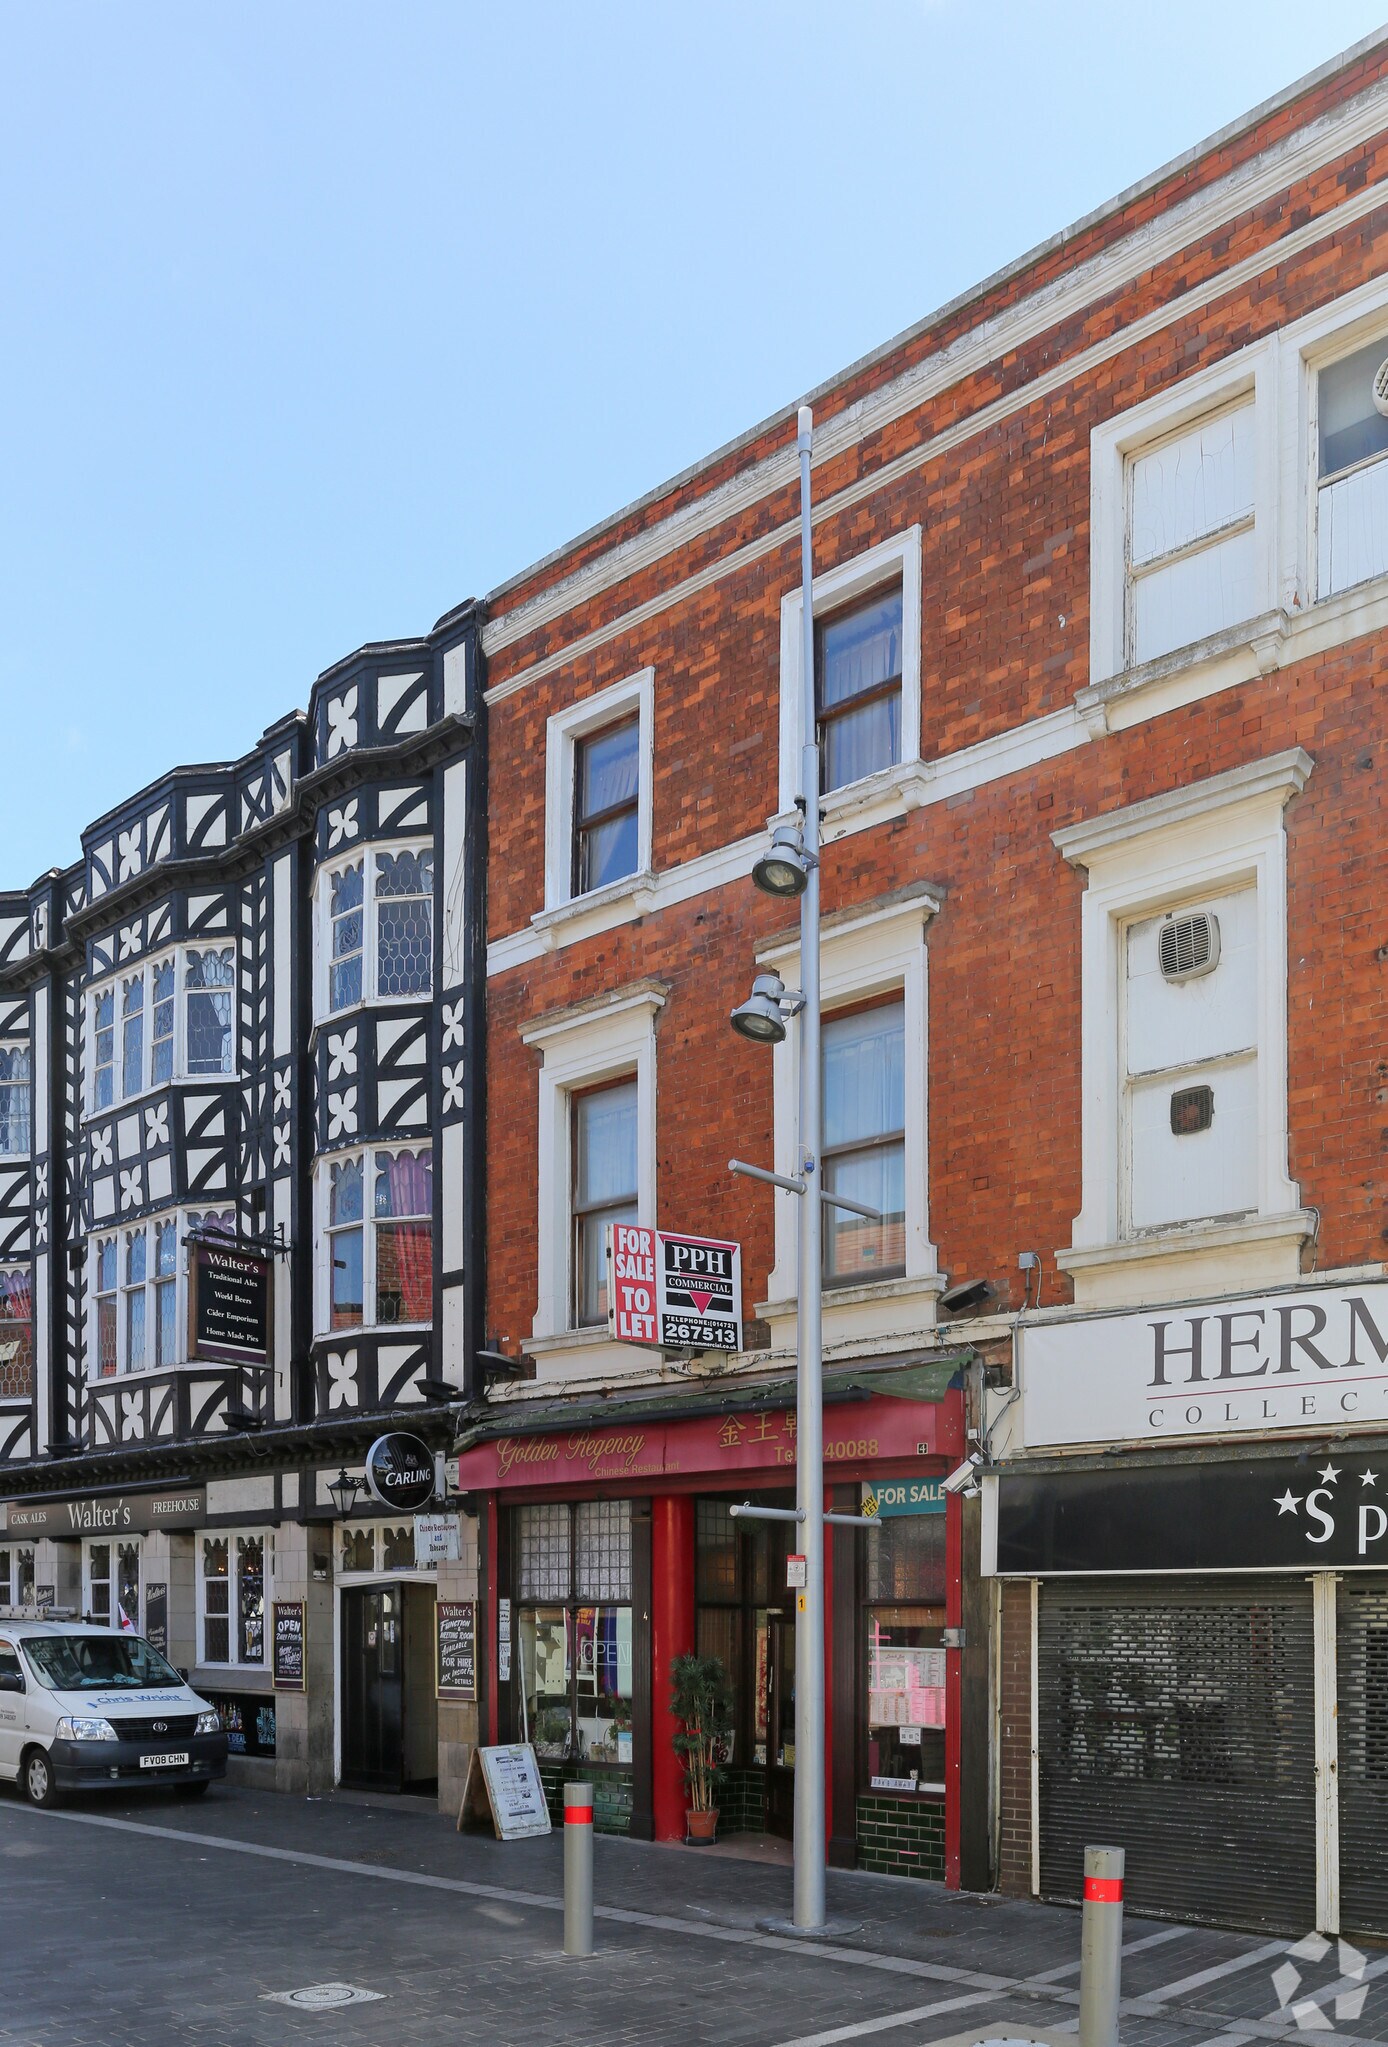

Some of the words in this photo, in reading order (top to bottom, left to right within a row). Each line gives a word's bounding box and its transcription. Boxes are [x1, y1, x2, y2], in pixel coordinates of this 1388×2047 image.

[618, 1227, 651, 1256] FOR
[208, 1252, 259, 1273] Walter's
[616, 1253, 654, 1282] SALE
[672, 1245, 726, 1275] PPH
[208, 1271, 242, 1284] Traditional
[244, 1279, 258, 1287] Ales
[668, 1277, 731, 1293] COMMERCIAL
[214, 1291, 233, 1300] World
[235, 1294, 252, 1304] Beers
[621, 1286, 650, 1312] TO
[206, 1308, 225, 1318] Cider
[226, 1312, 259, 1324] Emporium
[620, 1311, 655, 1339] LET
[665, 1322, 736, 1344] 267513
[206, 1327, 225, 1337] Home
[227, 1330, 245, 1340] Made
[246, 1334, 259, 1343] Pies
[664, 1338, 737, 1350] www.pph-commercial.co.uk
[497, 1436, 560, 1477] Golden
[565, 1431, 645, 1470] Regency
[385, 1468, 431, 1486] CARLING
[595, 1465, 629, 1477] Chinese
[877, 1487, 906, 1505] FOR
[909, 1484, 946, 1502] SALE
[860, 1495, 875, 1511] MAY
[865, 1503, 878, 1517] LET
[11, 1514, 29, 1525] CASK
[30, 1512, 47, 1523] ALES
[67, 1499, 131, 1529] Walter's
[152, 1499, 199, 1513] FREEHOUSE
[277, 1606, 302, 1616] Walter's
[441, 1606, 472, 1616] Walter's
[799, 1598, 803, 1609] 1
[277, 1620, 301, 1633] OPEN
[440, 1619, 471, 1632] FUNCTION
[442, 1641, 467, 1656] AVAILABLE
[583, 1643, 630, 1663] OPEN
[442, 1657, 455, 1666] FOR
[457, 1658, 472, 1667] HIRE
[452, 1668, 466, 1677] INSIDE
[98, 1696, 133, 1704] Chris
[143, 1755, 167, 1766] FV08
[168, 1754, 185, 1764] CHN
